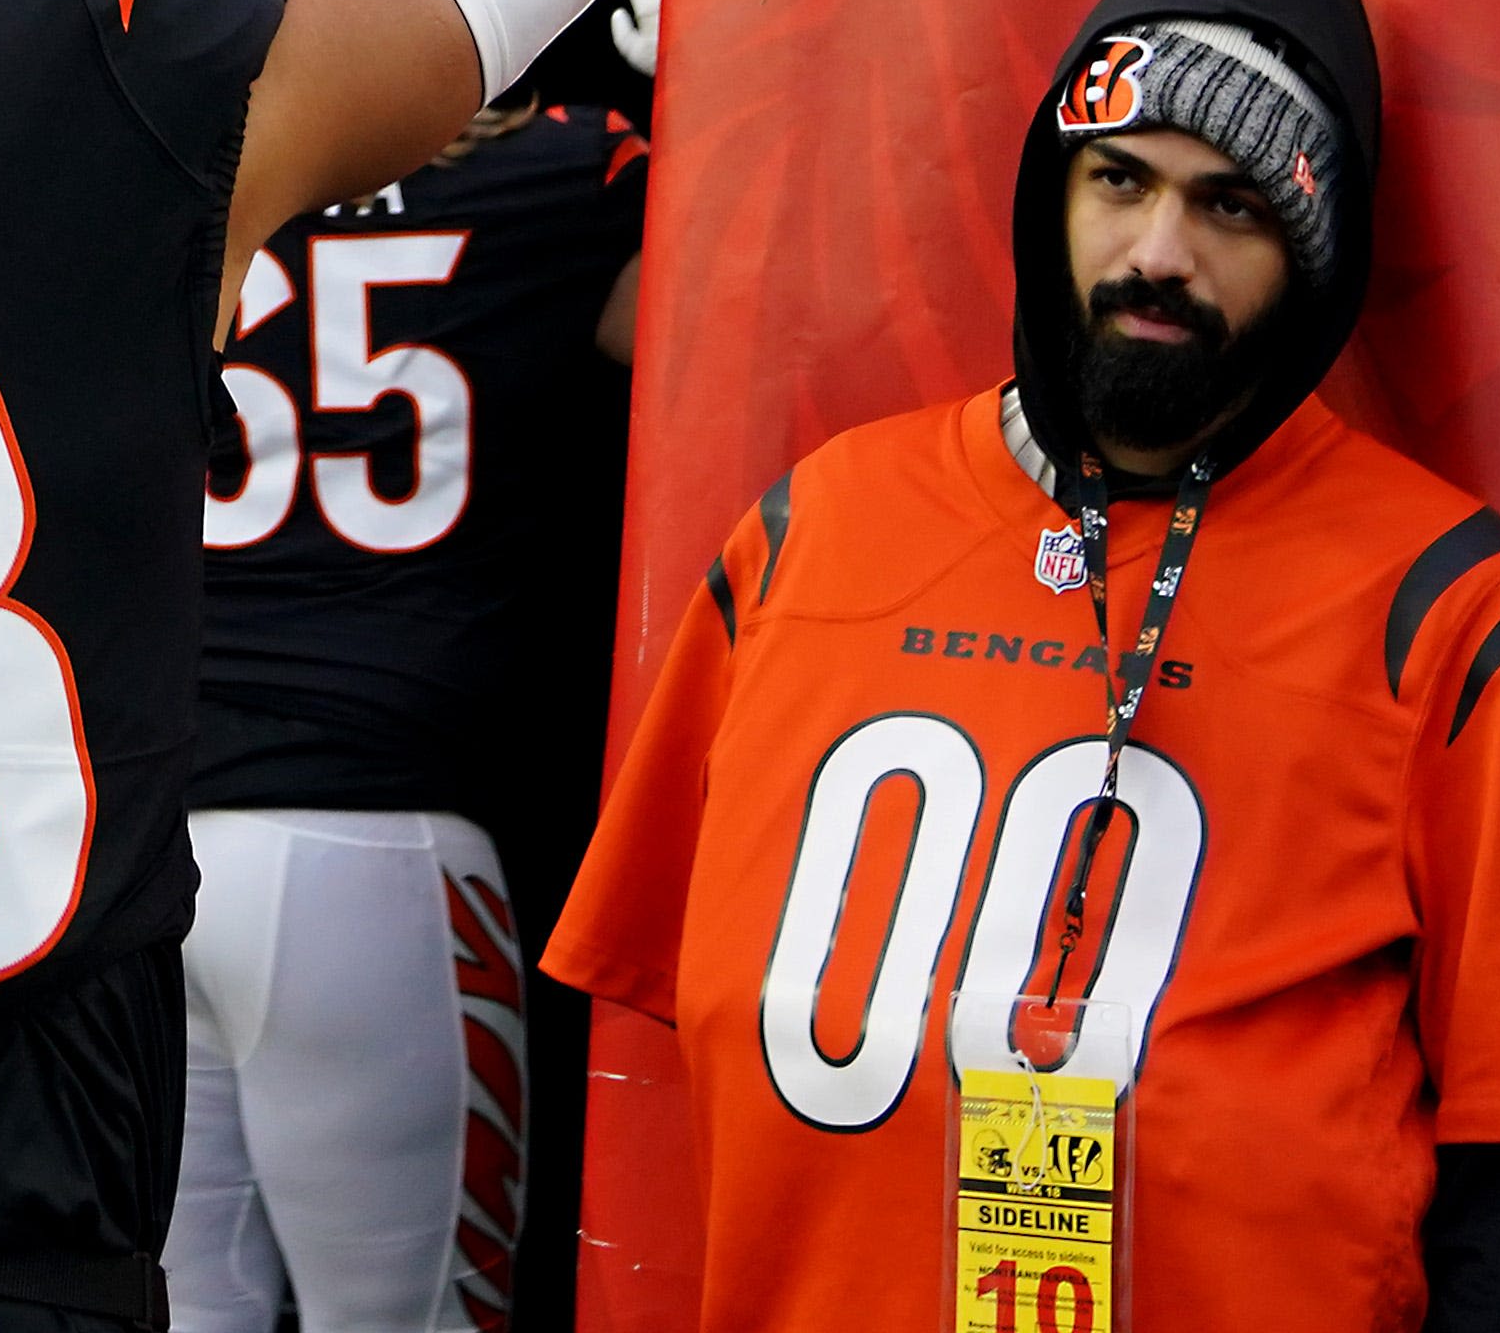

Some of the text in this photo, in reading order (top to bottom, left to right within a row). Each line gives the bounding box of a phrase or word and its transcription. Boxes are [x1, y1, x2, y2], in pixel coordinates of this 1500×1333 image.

[1042, 555, 1081, 582] NFL
[759, 710, 1207, 1134] 00
[979, 1206, 1089, 1233] SIDELINE
[977, 1259, 1094, 1333] 10
